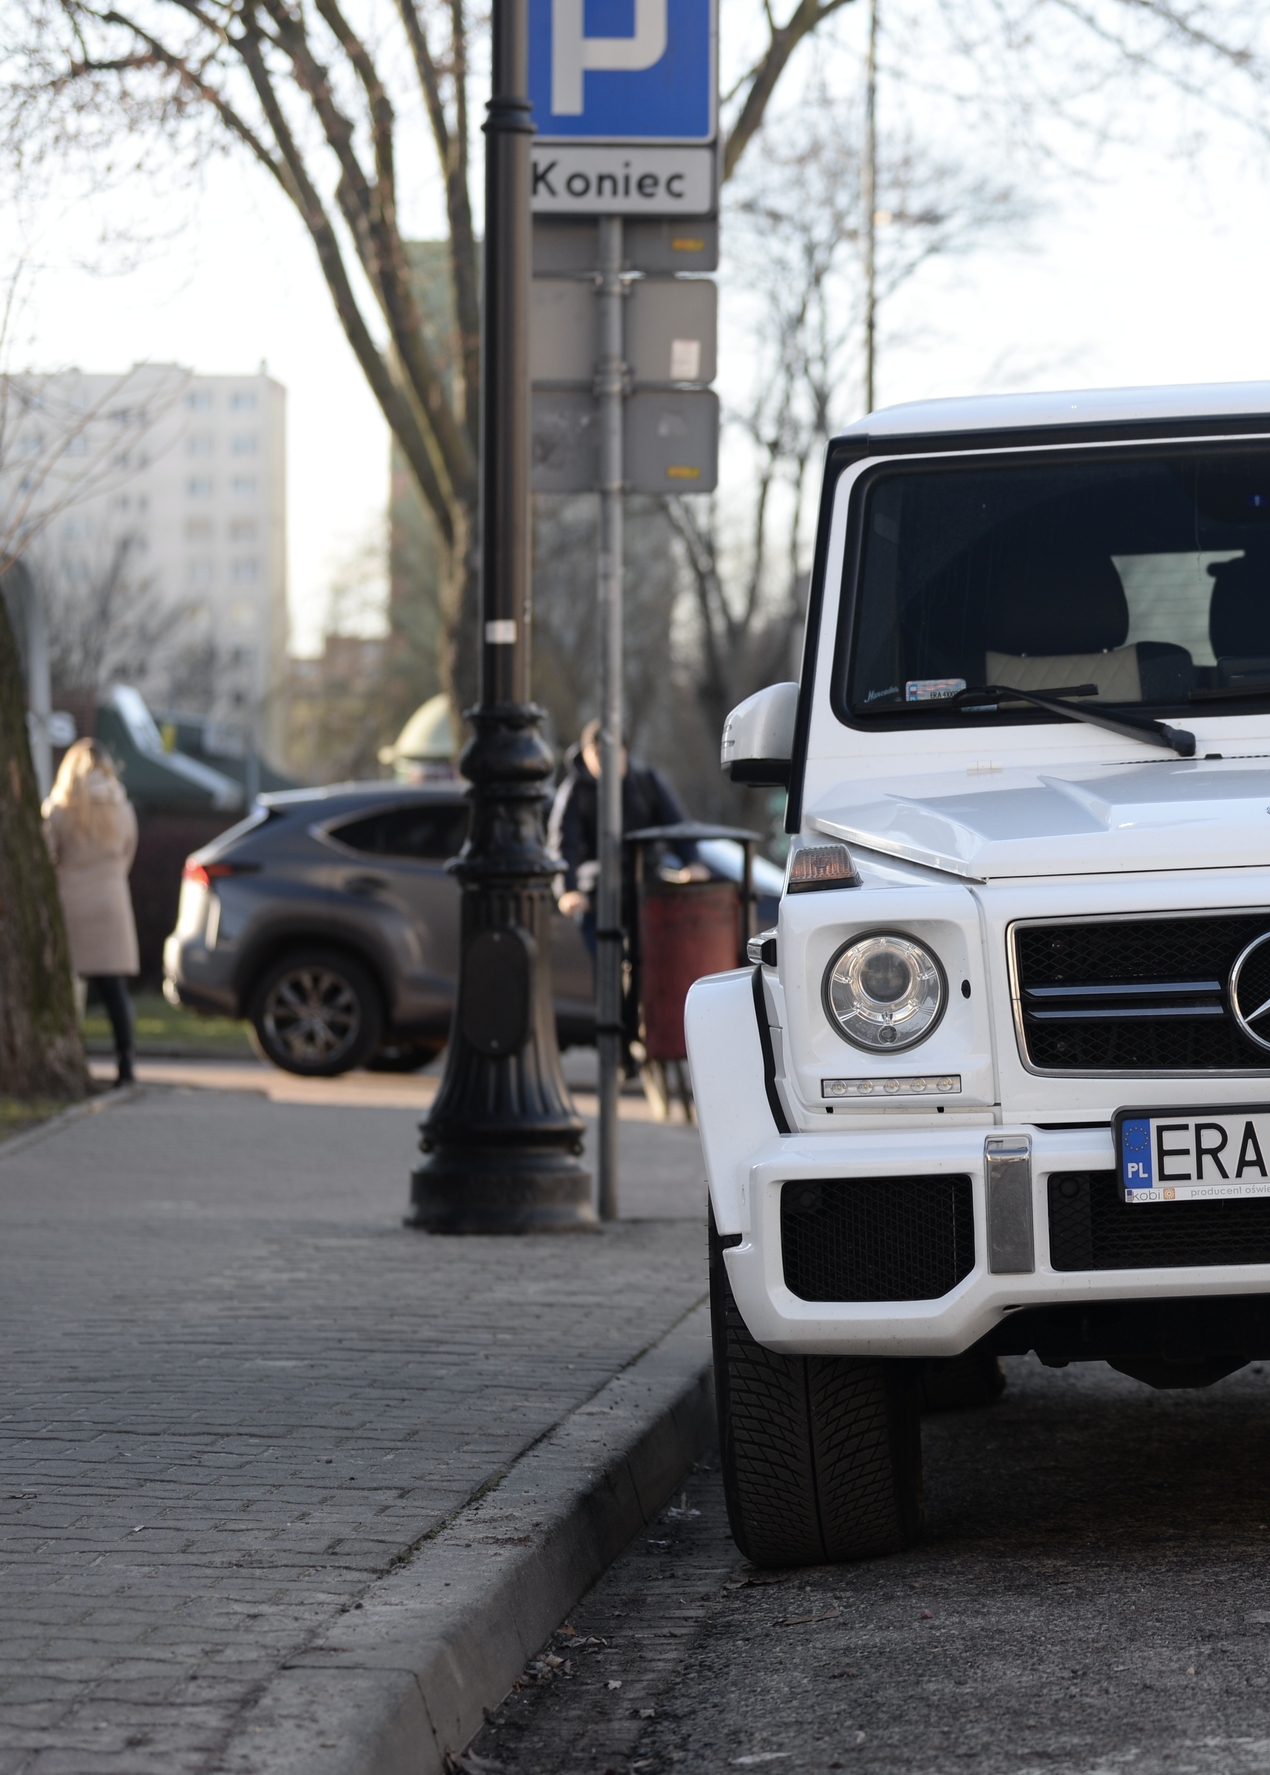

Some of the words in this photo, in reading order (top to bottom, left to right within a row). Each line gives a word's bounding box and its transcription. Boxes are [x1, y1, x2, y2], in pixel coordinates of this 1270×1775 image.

[551, 0, 668, 117] P
[532, 161, 687, 200] Koniec
[864, 686, 900, 703] Mercedes
[1156, 1120, 1268, 1182] ERA
[1127, 1163, 1149, 1179] PL
[1132, 1189, 1161, 1202] kobi
[1190, 1186, 1242, 1198] producent
